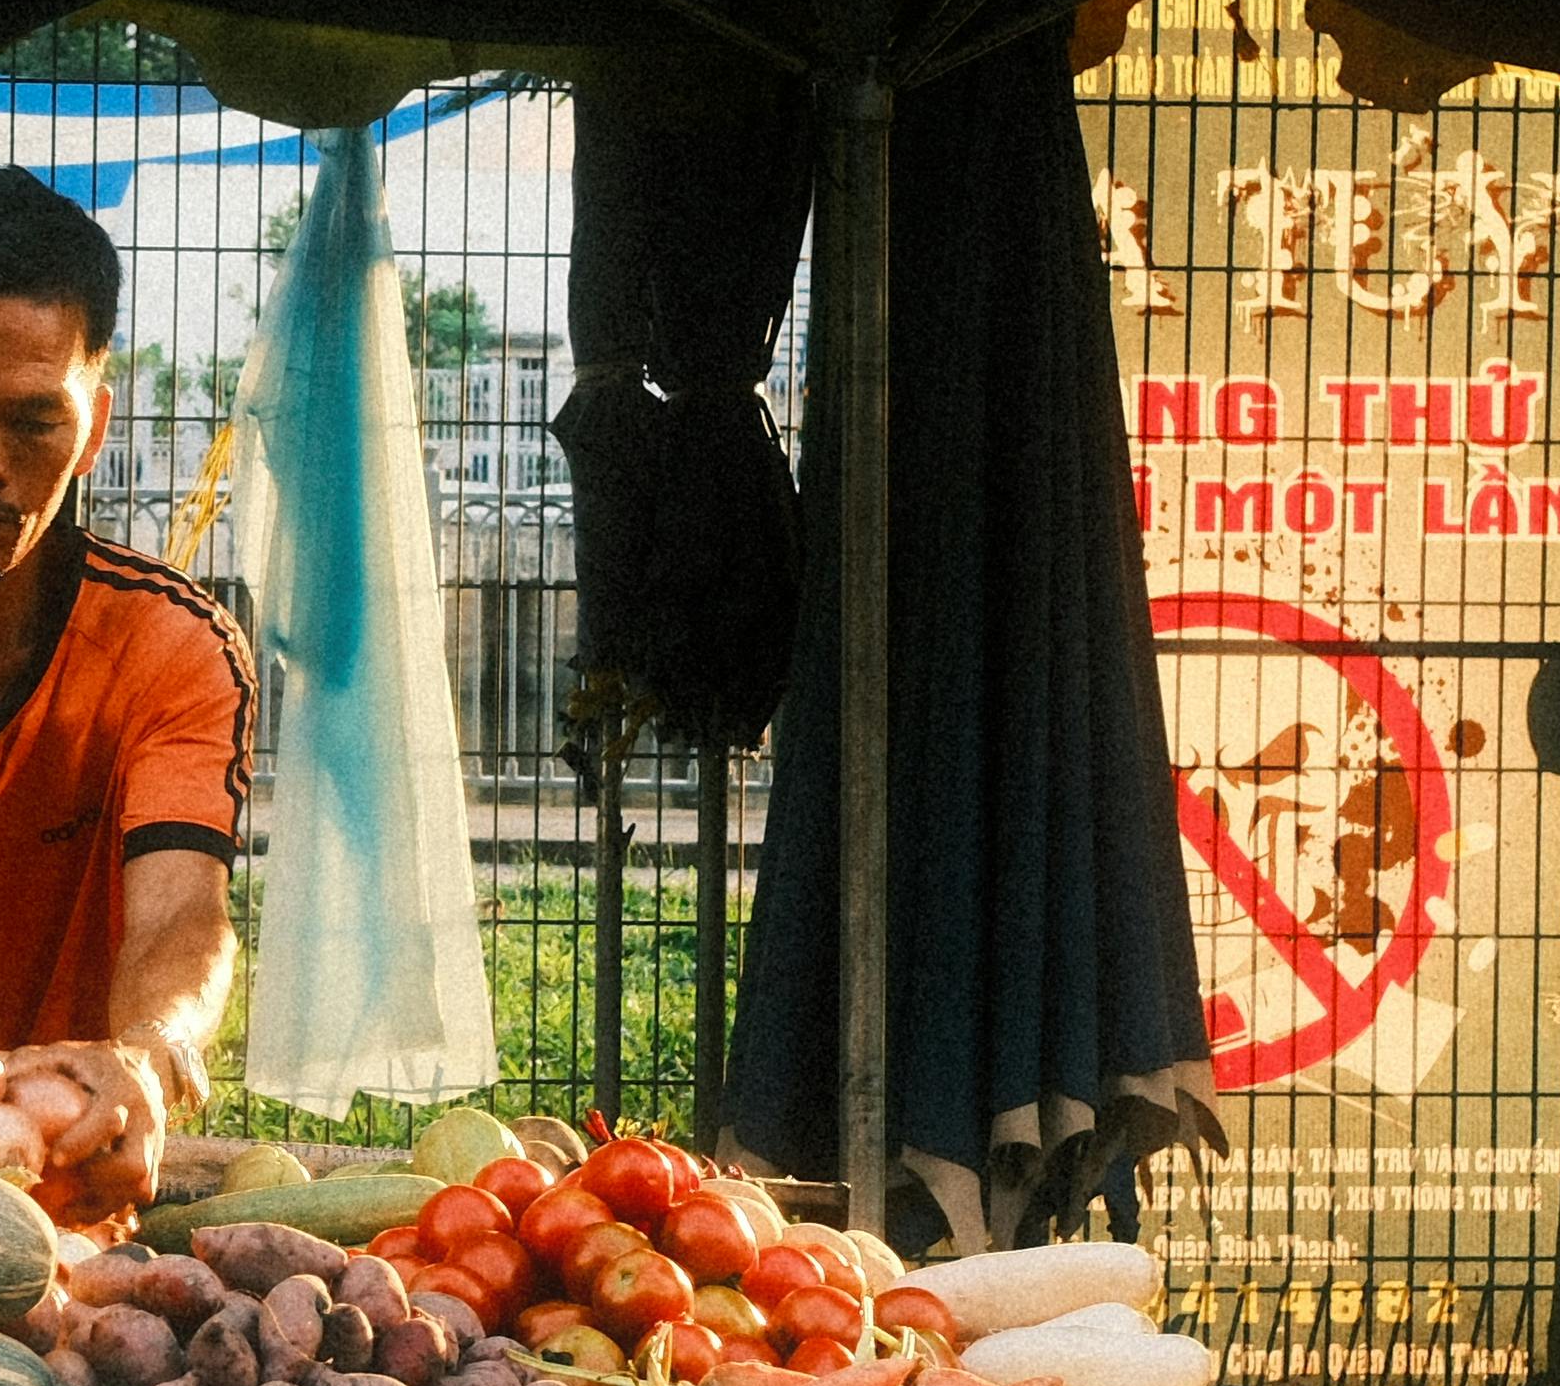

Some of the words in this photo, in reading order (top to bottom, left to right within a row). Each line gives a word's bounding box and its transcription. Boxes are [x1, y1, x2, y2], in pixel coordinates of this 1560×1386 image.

[1323, 361, 1541, 450] THỬ
[1191, 468, 1389, 545] MỘT
[1252, 1186, 1288, 1211] MA
